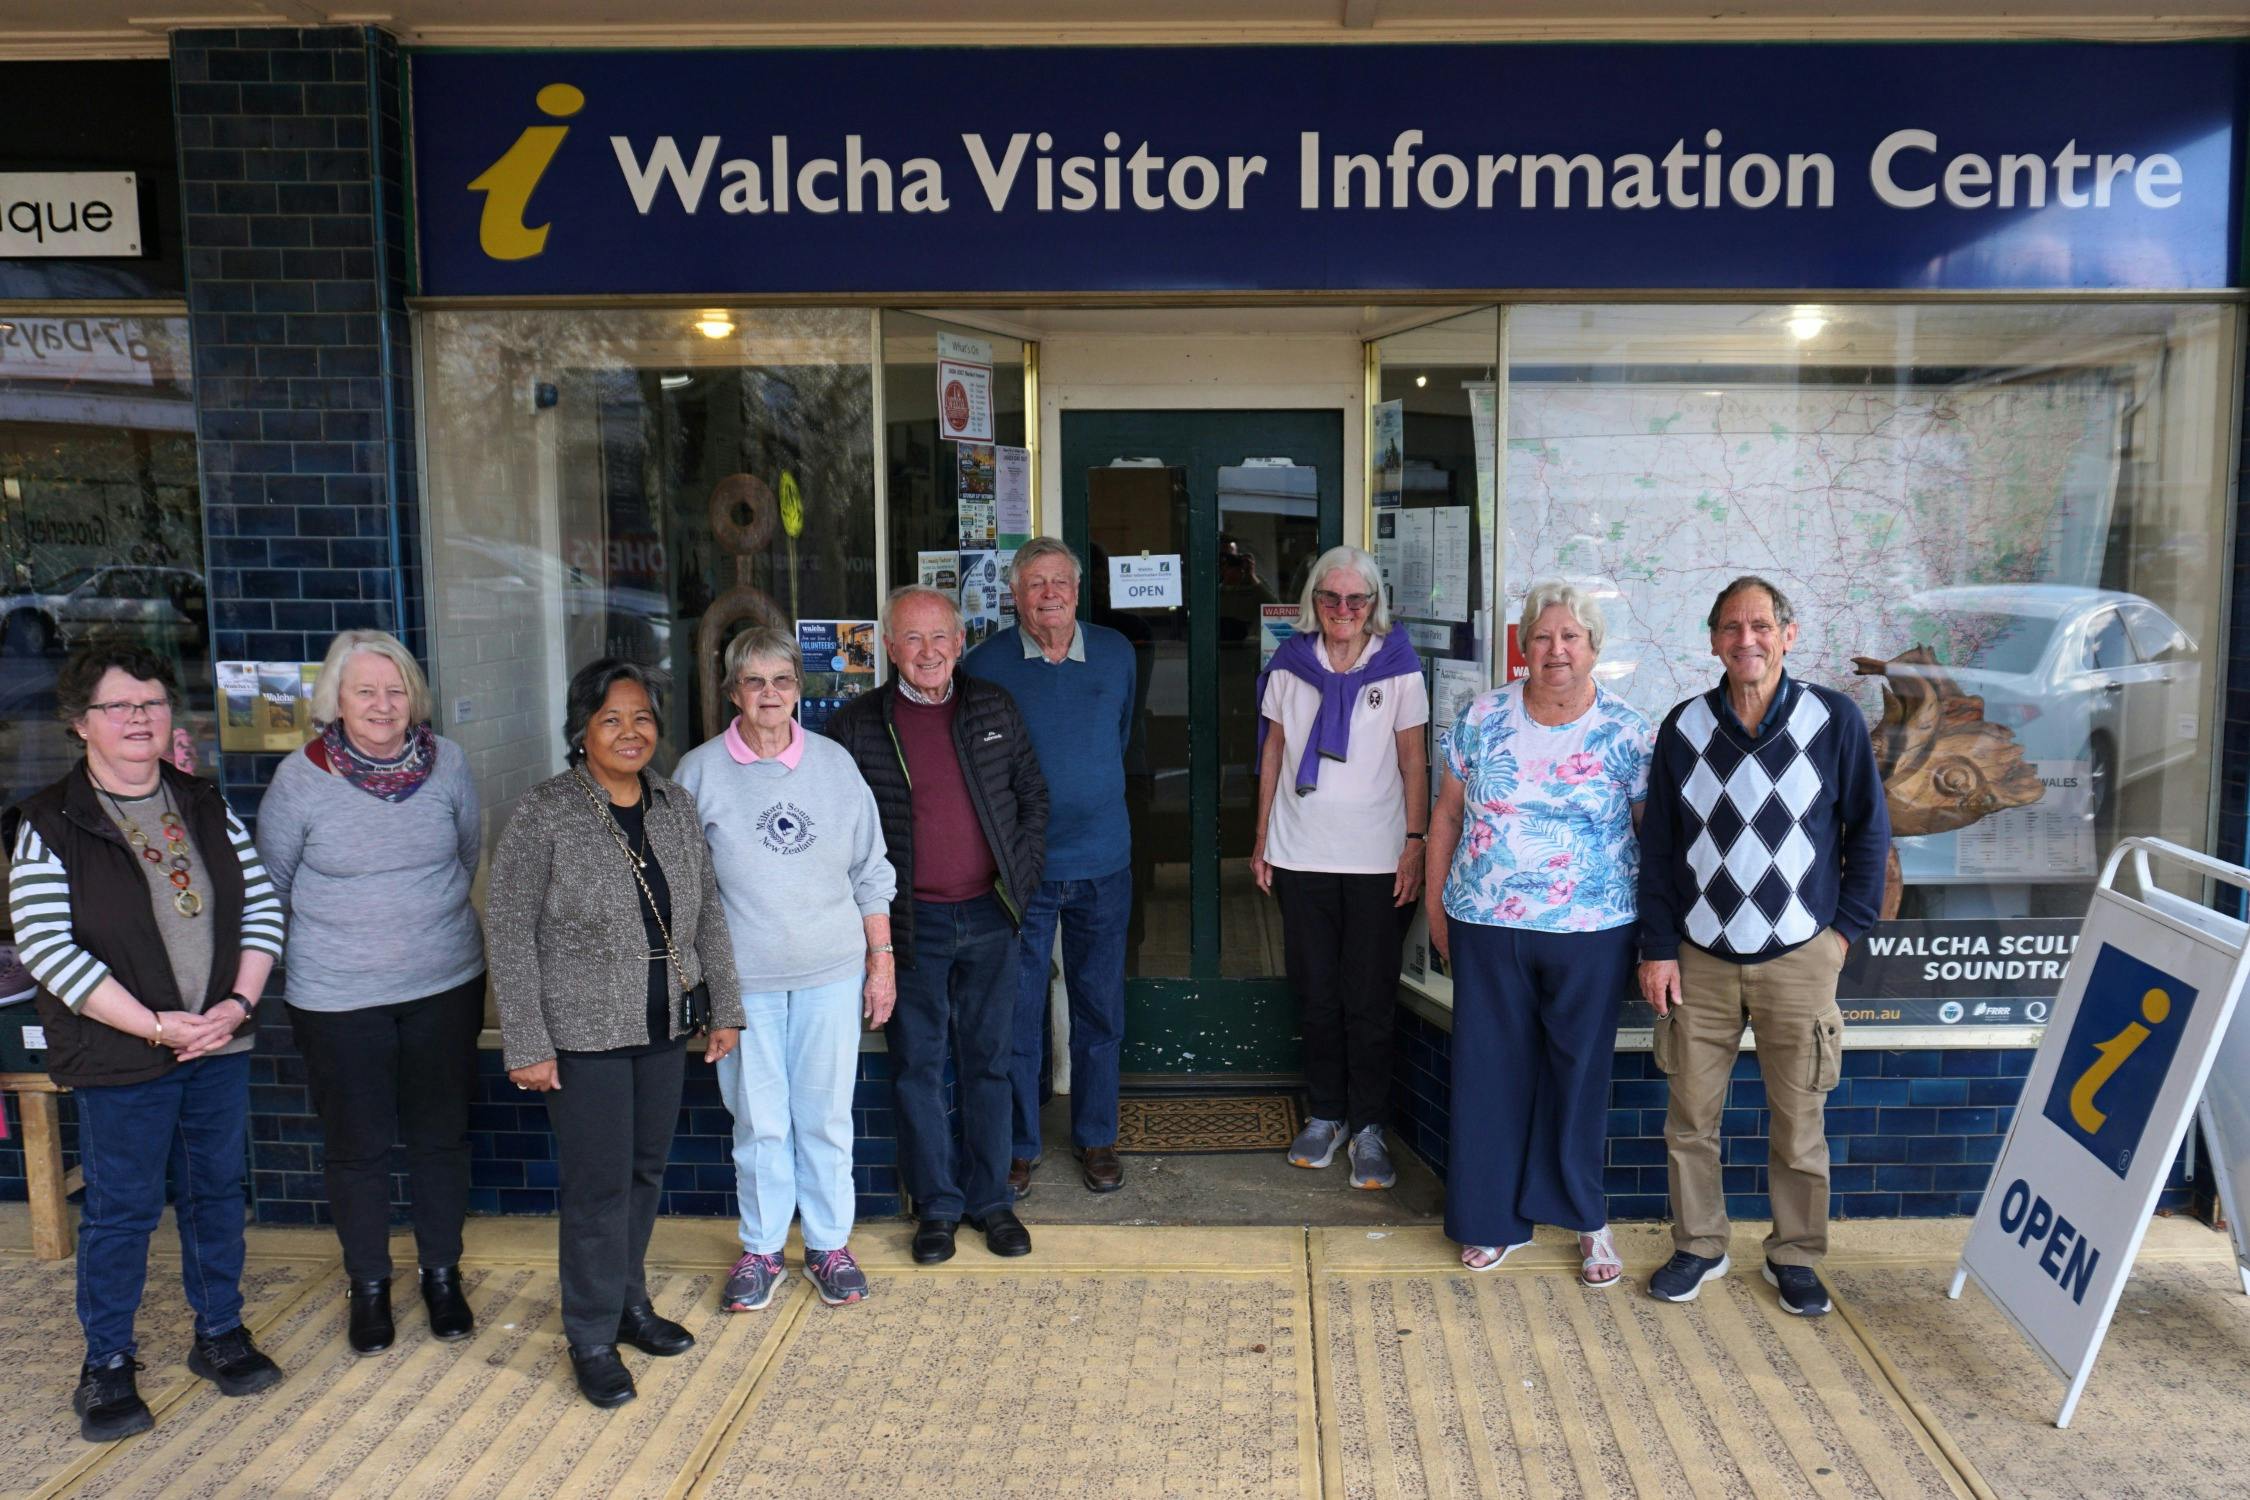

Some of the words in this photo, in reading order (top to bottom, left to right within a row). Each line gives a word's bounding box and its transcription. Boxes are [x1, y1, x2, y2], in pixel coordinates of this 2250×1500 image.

[609, 133, 951, 216] Walcha
[961, 130, 1268, 214] Visitor
[1299, 128, 1835, 211] Information
[1868, 128, 2184, 211] Centre
[952, 340, 971, 355] What's
[1128, 585, 1164, 597] OPEN
[800, 641, 837, 650] VOLUNTEERS!
[756, 801, 783, 831] Milford
[787, 802, 815, 827] Sound
[759, 836, 780, 853] New
[781, 833, 817, 855] Zealand
[1868, 935, 1990, 958] WALCHA
[1985, 1006, 2011, 1016] FRRR
[1999, 1178, 2101, 1306] OPEN
